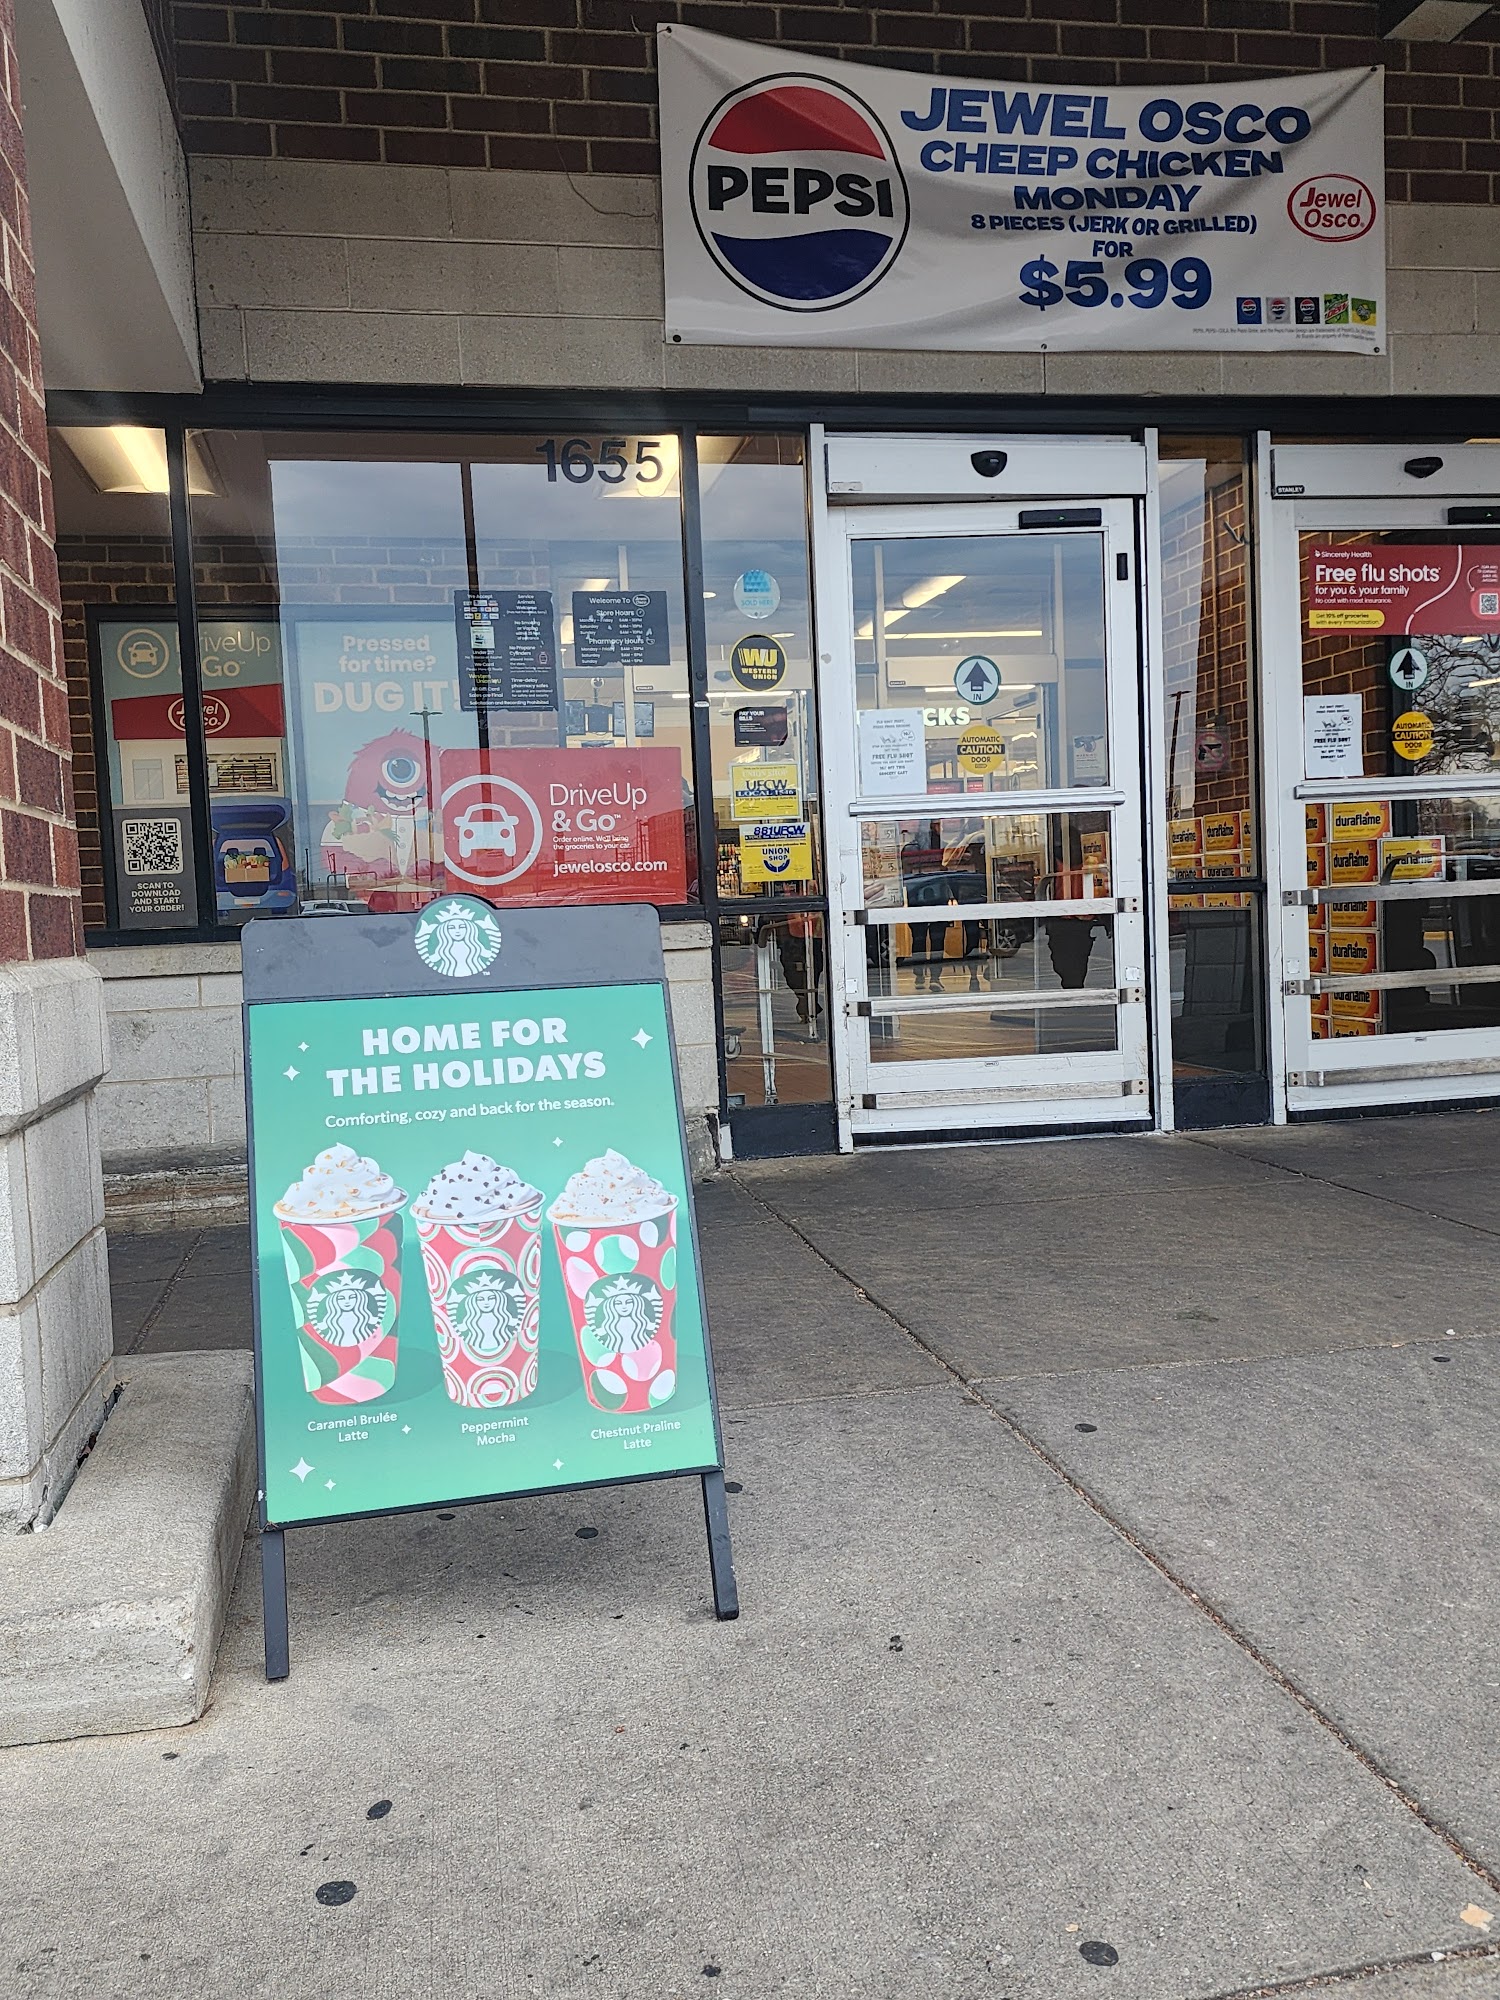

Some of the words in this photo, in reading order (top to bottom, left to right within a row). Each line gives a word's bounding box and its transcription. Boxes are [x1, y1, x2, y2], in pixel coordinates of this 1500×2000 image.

[900, 87, 1126, 140] JEWEL
[1138, 98, 1311, 144] OSCO
[920, 140, 1079, 176] CHEEP
[1086, 148, 1284, 179] CHICKEN
[707, 165, 894, 218] PEPSI
[1013, 183, 1202, 212] MONDAY
[1299, 187, 1363, 208] Jewel
[971, 214, 986, 230] 8
[989, 215, 1065, 231] PIECES
[1068, 215, 1128, 235] (JERK
[1132, 218, 1160, 236] OR
[1163, 214, 1258, 235] GRILLED)
[1092, 240, 1134, 258] FOR
[1018, 254, 1212, 312] $5.99
[535, 438, 664, 484] 1655
[1321, 551, 1350, 559] Sincerely
[1315, 564, 1356, 583] Free
[1361, 563, 1385, 583] flu
[1315, 585, 1329, 595] for
[1330, 587, 1347, 597] you
[1349, 586, 1357, 595] &
[1358, 587, 1379, 597] your
[1381, 585, 1410, 597] family
[175, 630, 272, 657] riveUp
[342, 634, 431, 652] Pressed
[338, 655, 371, 673] for
[374, 654, 437, 673] time?
[314, 681, 405, 713] DUG
[413, 679, 460, 712] IT!
[961, 735, 1000, 743] AUTOMATIC
[1394, 731, 1432, 740] CAUTION
[1404, 741, 1423, 749] DOOR
[960, 745, 1002, 754] CAUTION
[745, 779, 788, 791] UFCW
[549, 782, 648, 811] DriveUp
[551, 809, 572, 833] &
[1335, 814, 1381, 827] duraflame
[552, 835, 573, 843] Order
[573, 834, 595, 842] online.
[595, 834, 611, 842] We'll
[612, 834, 630, 842] bring
[565, 843, 595, 851] groceries
[762, 847, 790, 855] UNION
[1333, 852, 1369, 868] duraflame
[553, 859, 668, 878] jewelosco.com
[131, 889, 181, 898] DOWNLOAD
[129, 905, 153, 913] YOUR
[154, 904, 185, 912] ORDER!
[1332, 943, 1368, 959] duraflame
[362, 1022, 482, 1056] HOME
[491, 1017, 569, 1047] FOR
[325, 1065, 402, 1097] THE
[412, 1051, 606, 1091] HOLIDAYS
[325, 1110, 413, 1128] Comforting,
[414, 1106, 447, 1122] cozy
[449, 1103, 477, 1119] and
[479, 1101, 514, 1116] back
[515, 1099, 536, 1114] for
[537, 1097, 562, 1112] the
[563, 1096, 616, 1110] season.
[307, 1416, 358, 1432] Caramel
[359, 1410, 398, 1426] Brulée
[461, 1416, 529, 1435] Peppermint
[590, 1424, 641, 1440] Chestnut
[643, 1419, 682, 1434] Praline
[338, 1429, 369, 1443] Latte
[476, 1431, 516, 1446] Mocha
[623, 1436, 653, 1450] Latte
